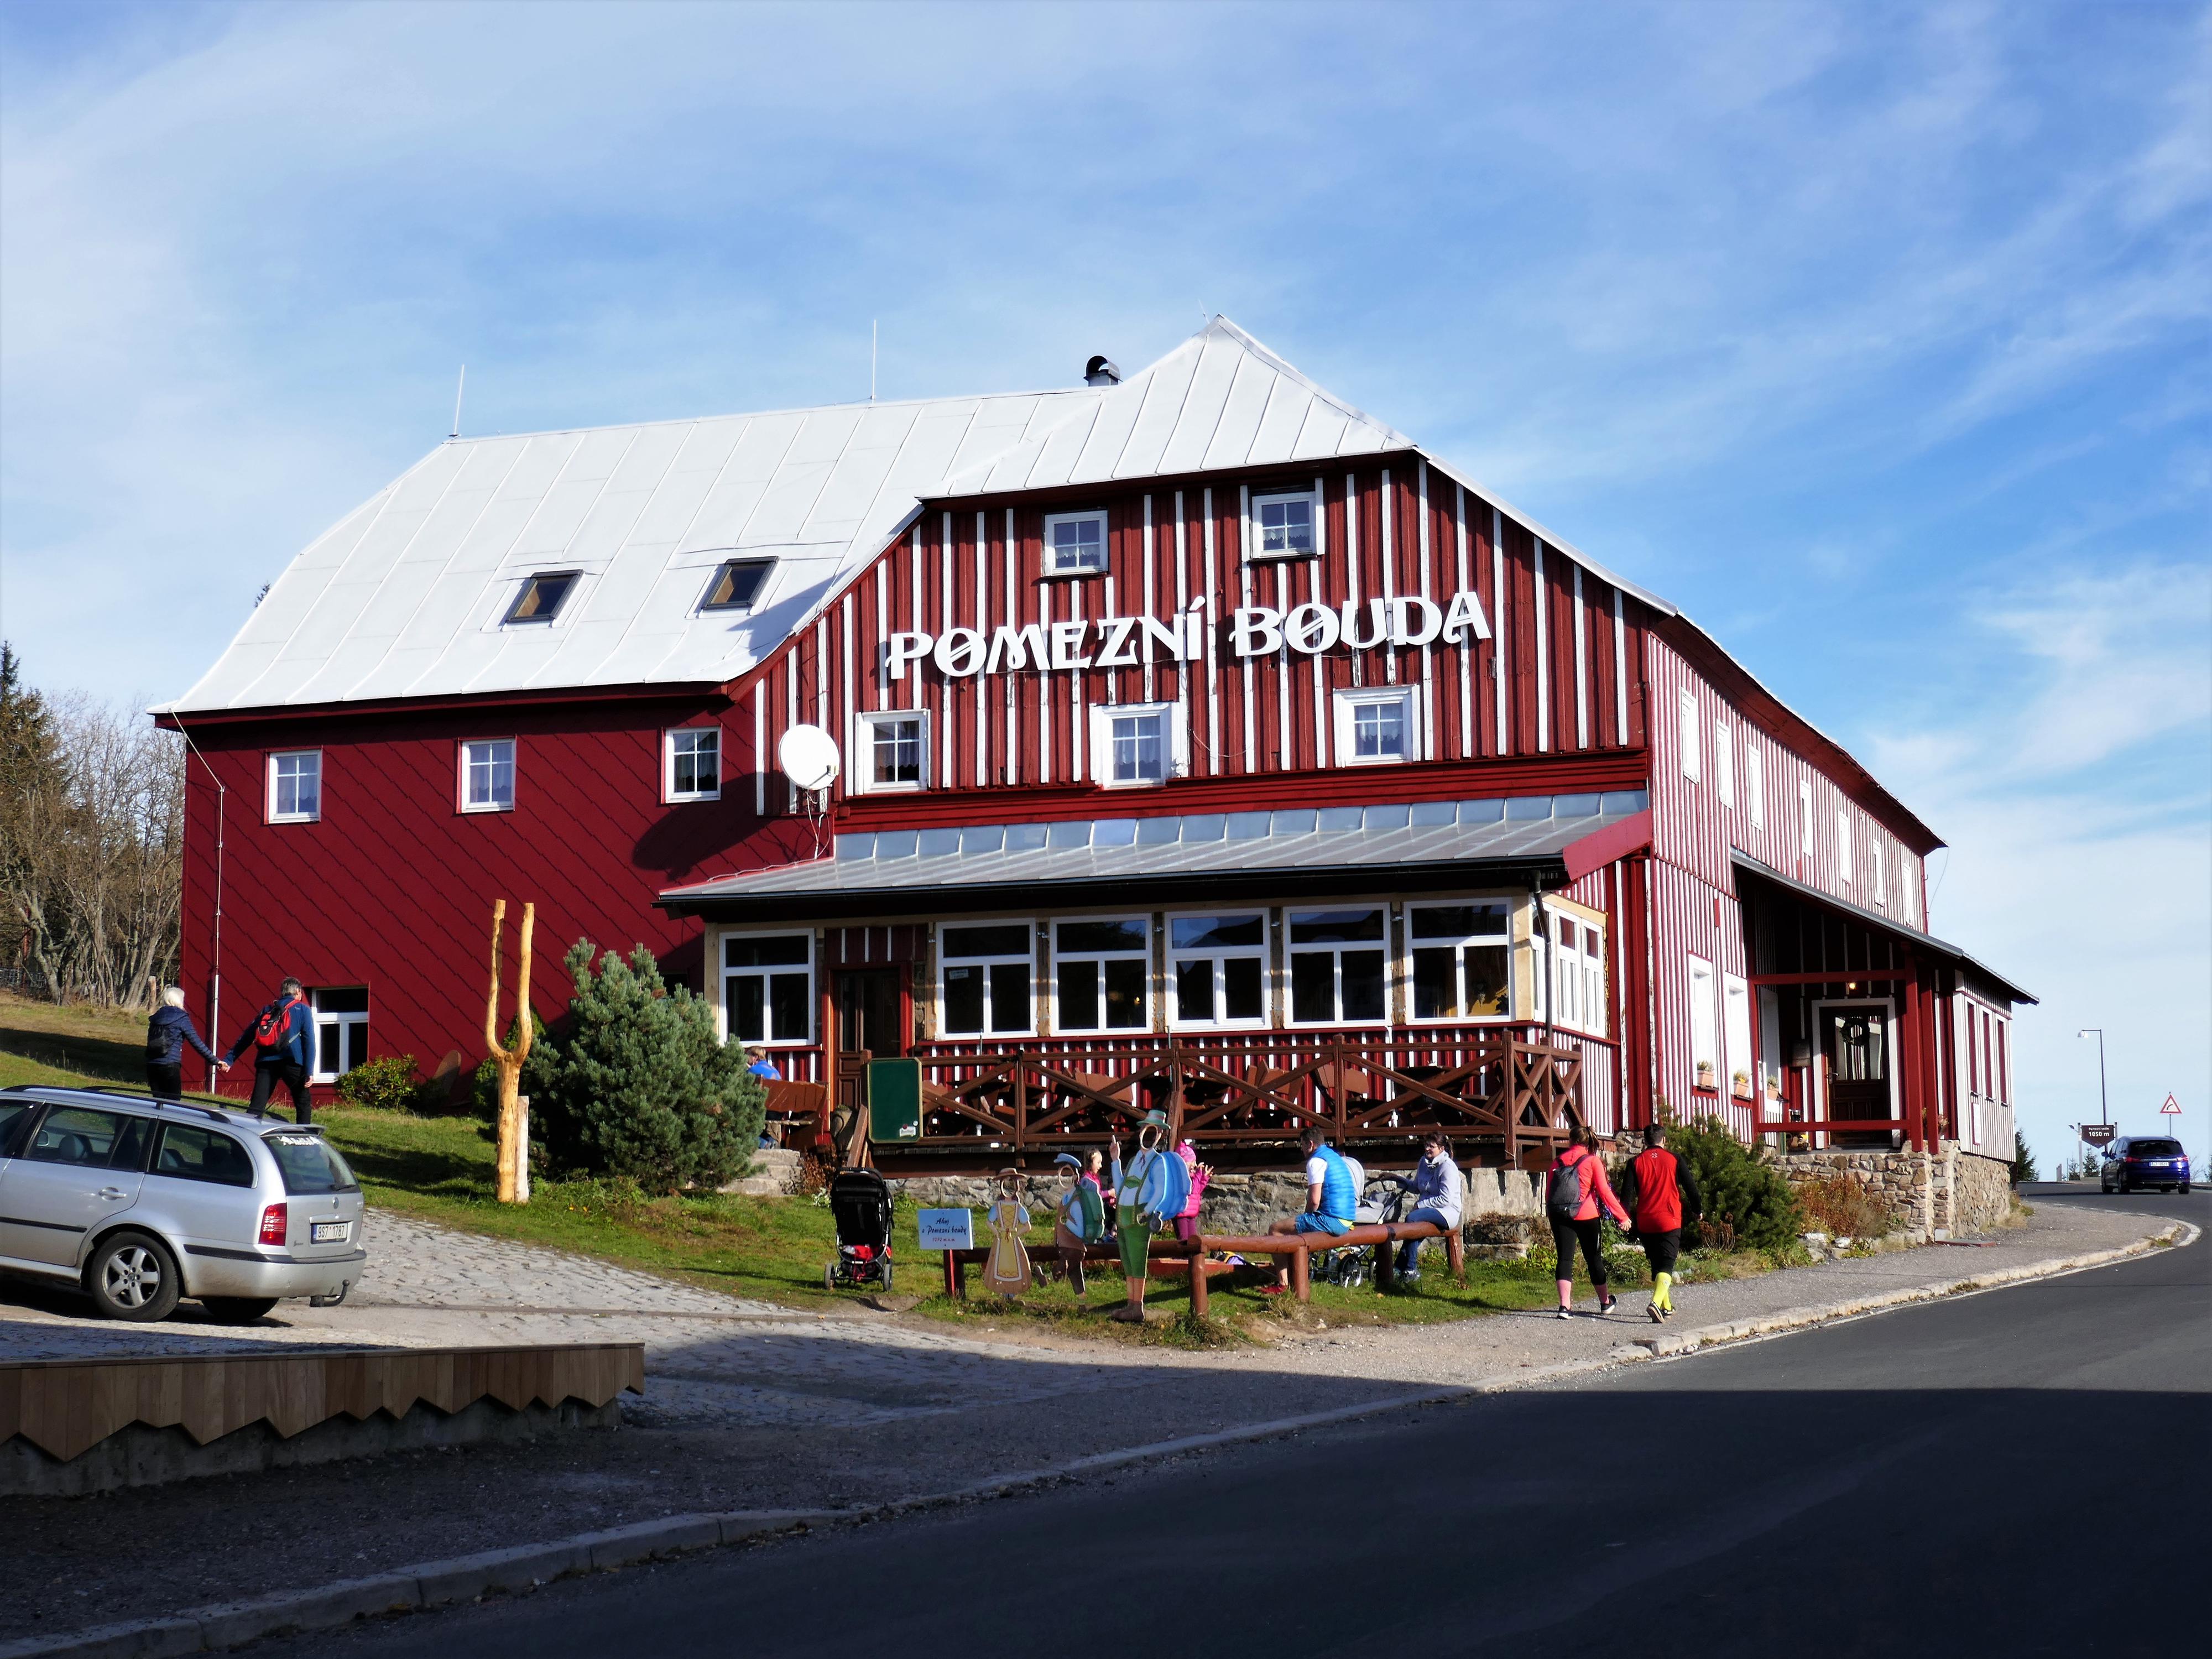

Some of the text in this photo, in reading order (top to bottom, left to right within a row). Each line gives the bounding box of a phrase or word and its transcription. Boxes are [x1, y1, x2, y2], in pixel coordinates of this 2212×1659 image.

[885, 591, 1492, 680] POMEZNÍ BOUDA
[318, 1225, 345, 1238] 9S7 1787
[926, 1225, 950, 1235] Pomezní
[952, 1225, 967, 1235] boudy
